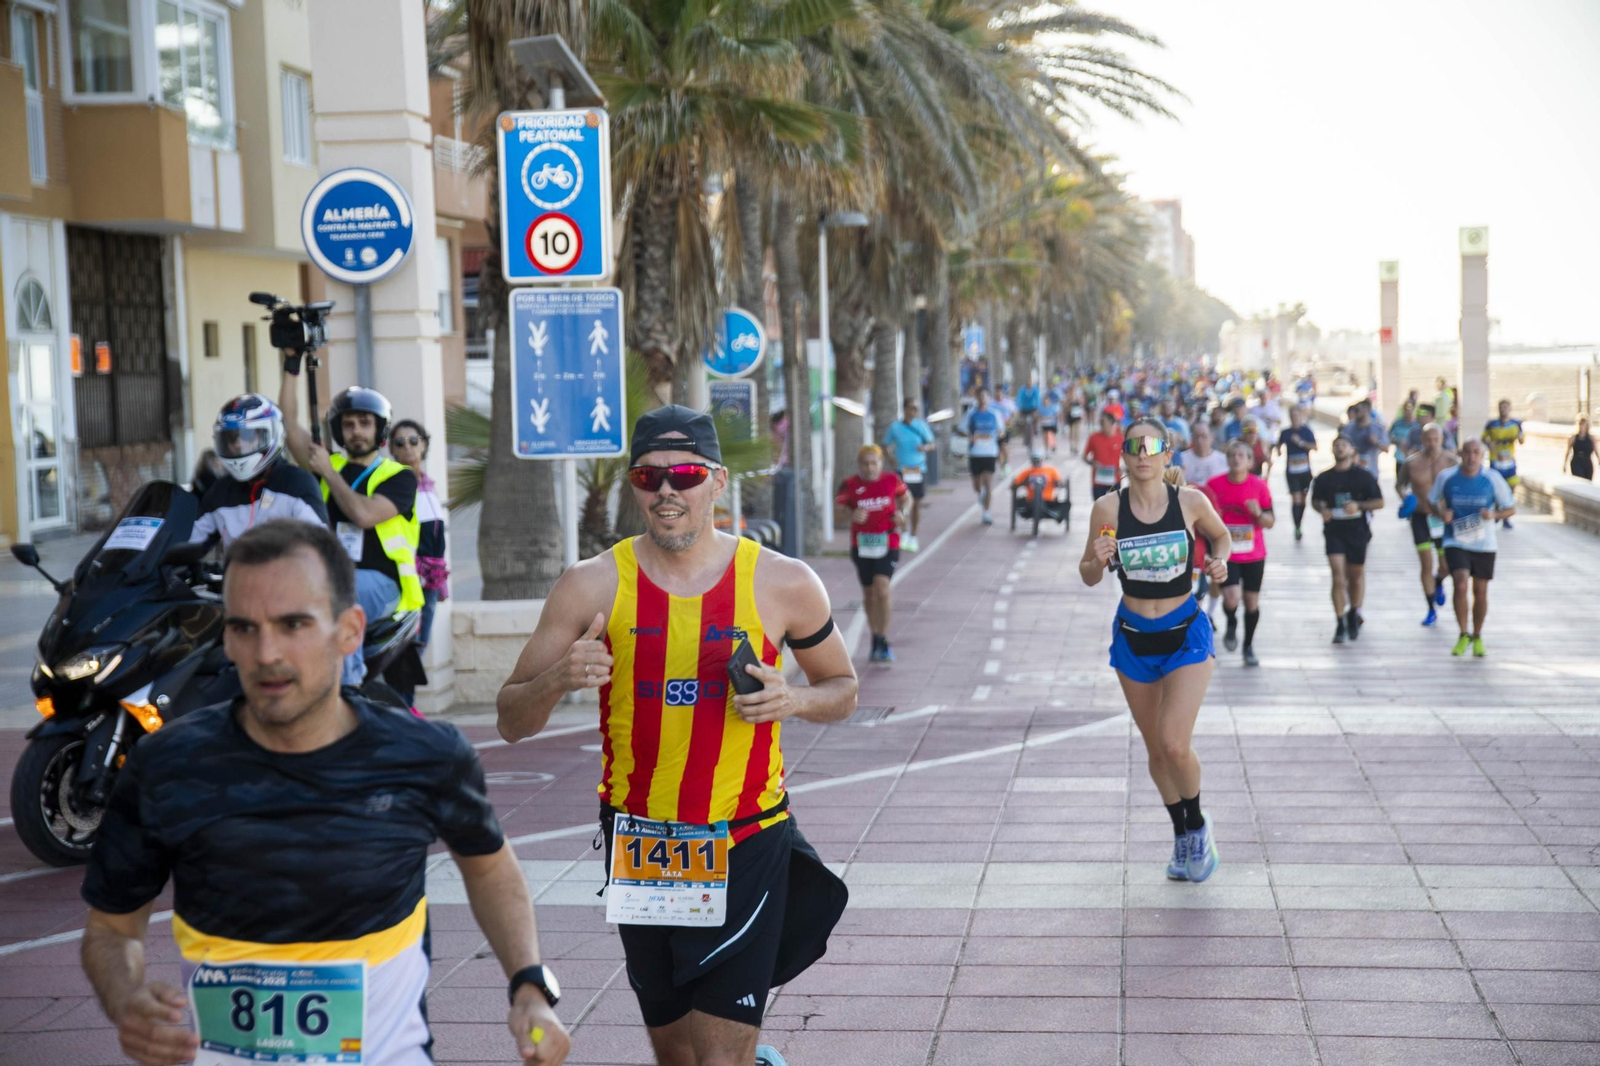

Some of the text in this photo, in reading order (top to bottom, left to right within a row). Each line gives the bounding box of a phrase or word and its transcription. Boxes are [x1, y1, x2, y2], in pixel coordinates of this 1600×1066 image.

[517, 115, 586, 129] PRIORIDAD
[518, 128, 585, 143] PEATONAL
[323, 203, 391, 221] ALMERÍA
[357, 220, 398, 231] MALTRATO
[539, 231, 570, 255] 10
[1128, 543, 1179, 565] 2131
[626, 837, 714, 871] 1411
[230, 987, 330, 1037] 816
